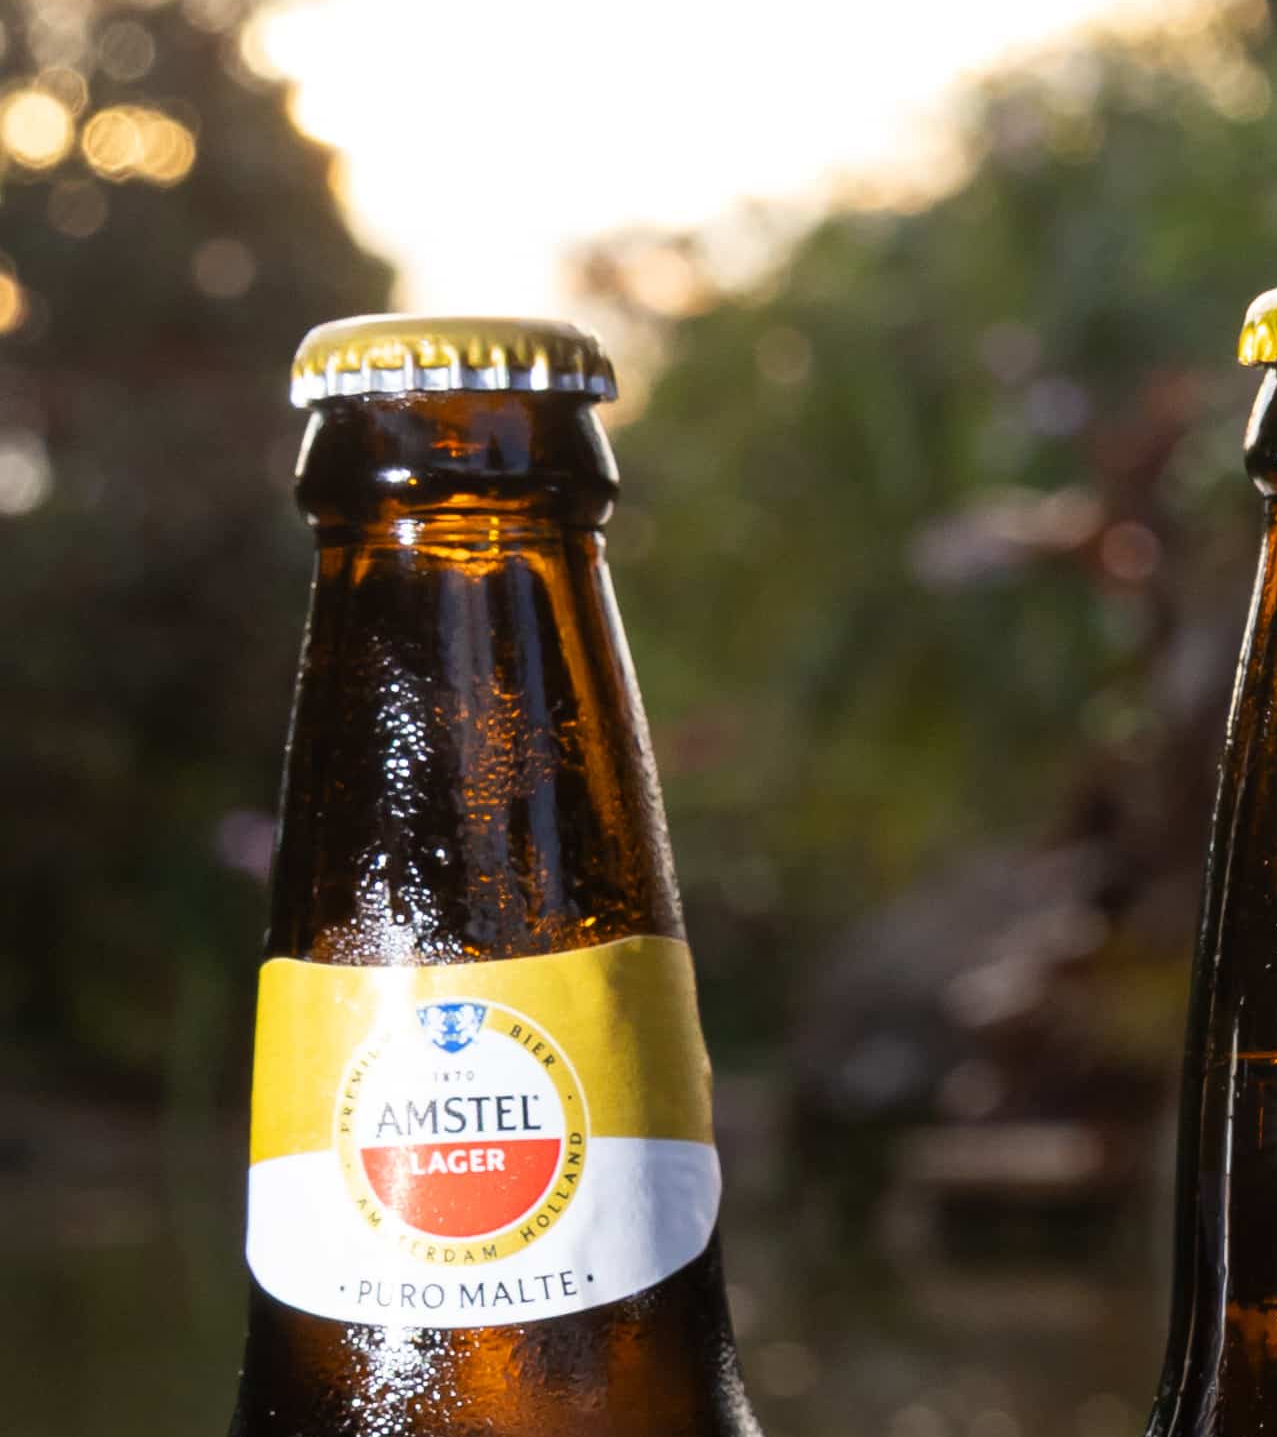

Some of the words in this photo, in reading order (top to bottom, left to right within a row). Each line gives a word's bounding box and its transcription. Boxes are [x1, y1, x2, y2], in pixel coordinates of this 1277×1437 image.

[510, 1024, 555, 1069] BIER
[433, 1070, 475, 1082] 1870
[375, 1095, 541, 1139] AMSTEL
[410, 1149, 506, 1176] LAGER
[520, 1131, 584, 1243] HOLLAND
[357, 1280, 446, 1310] PURO
[460, 1271, 578, 1308] MALTE
